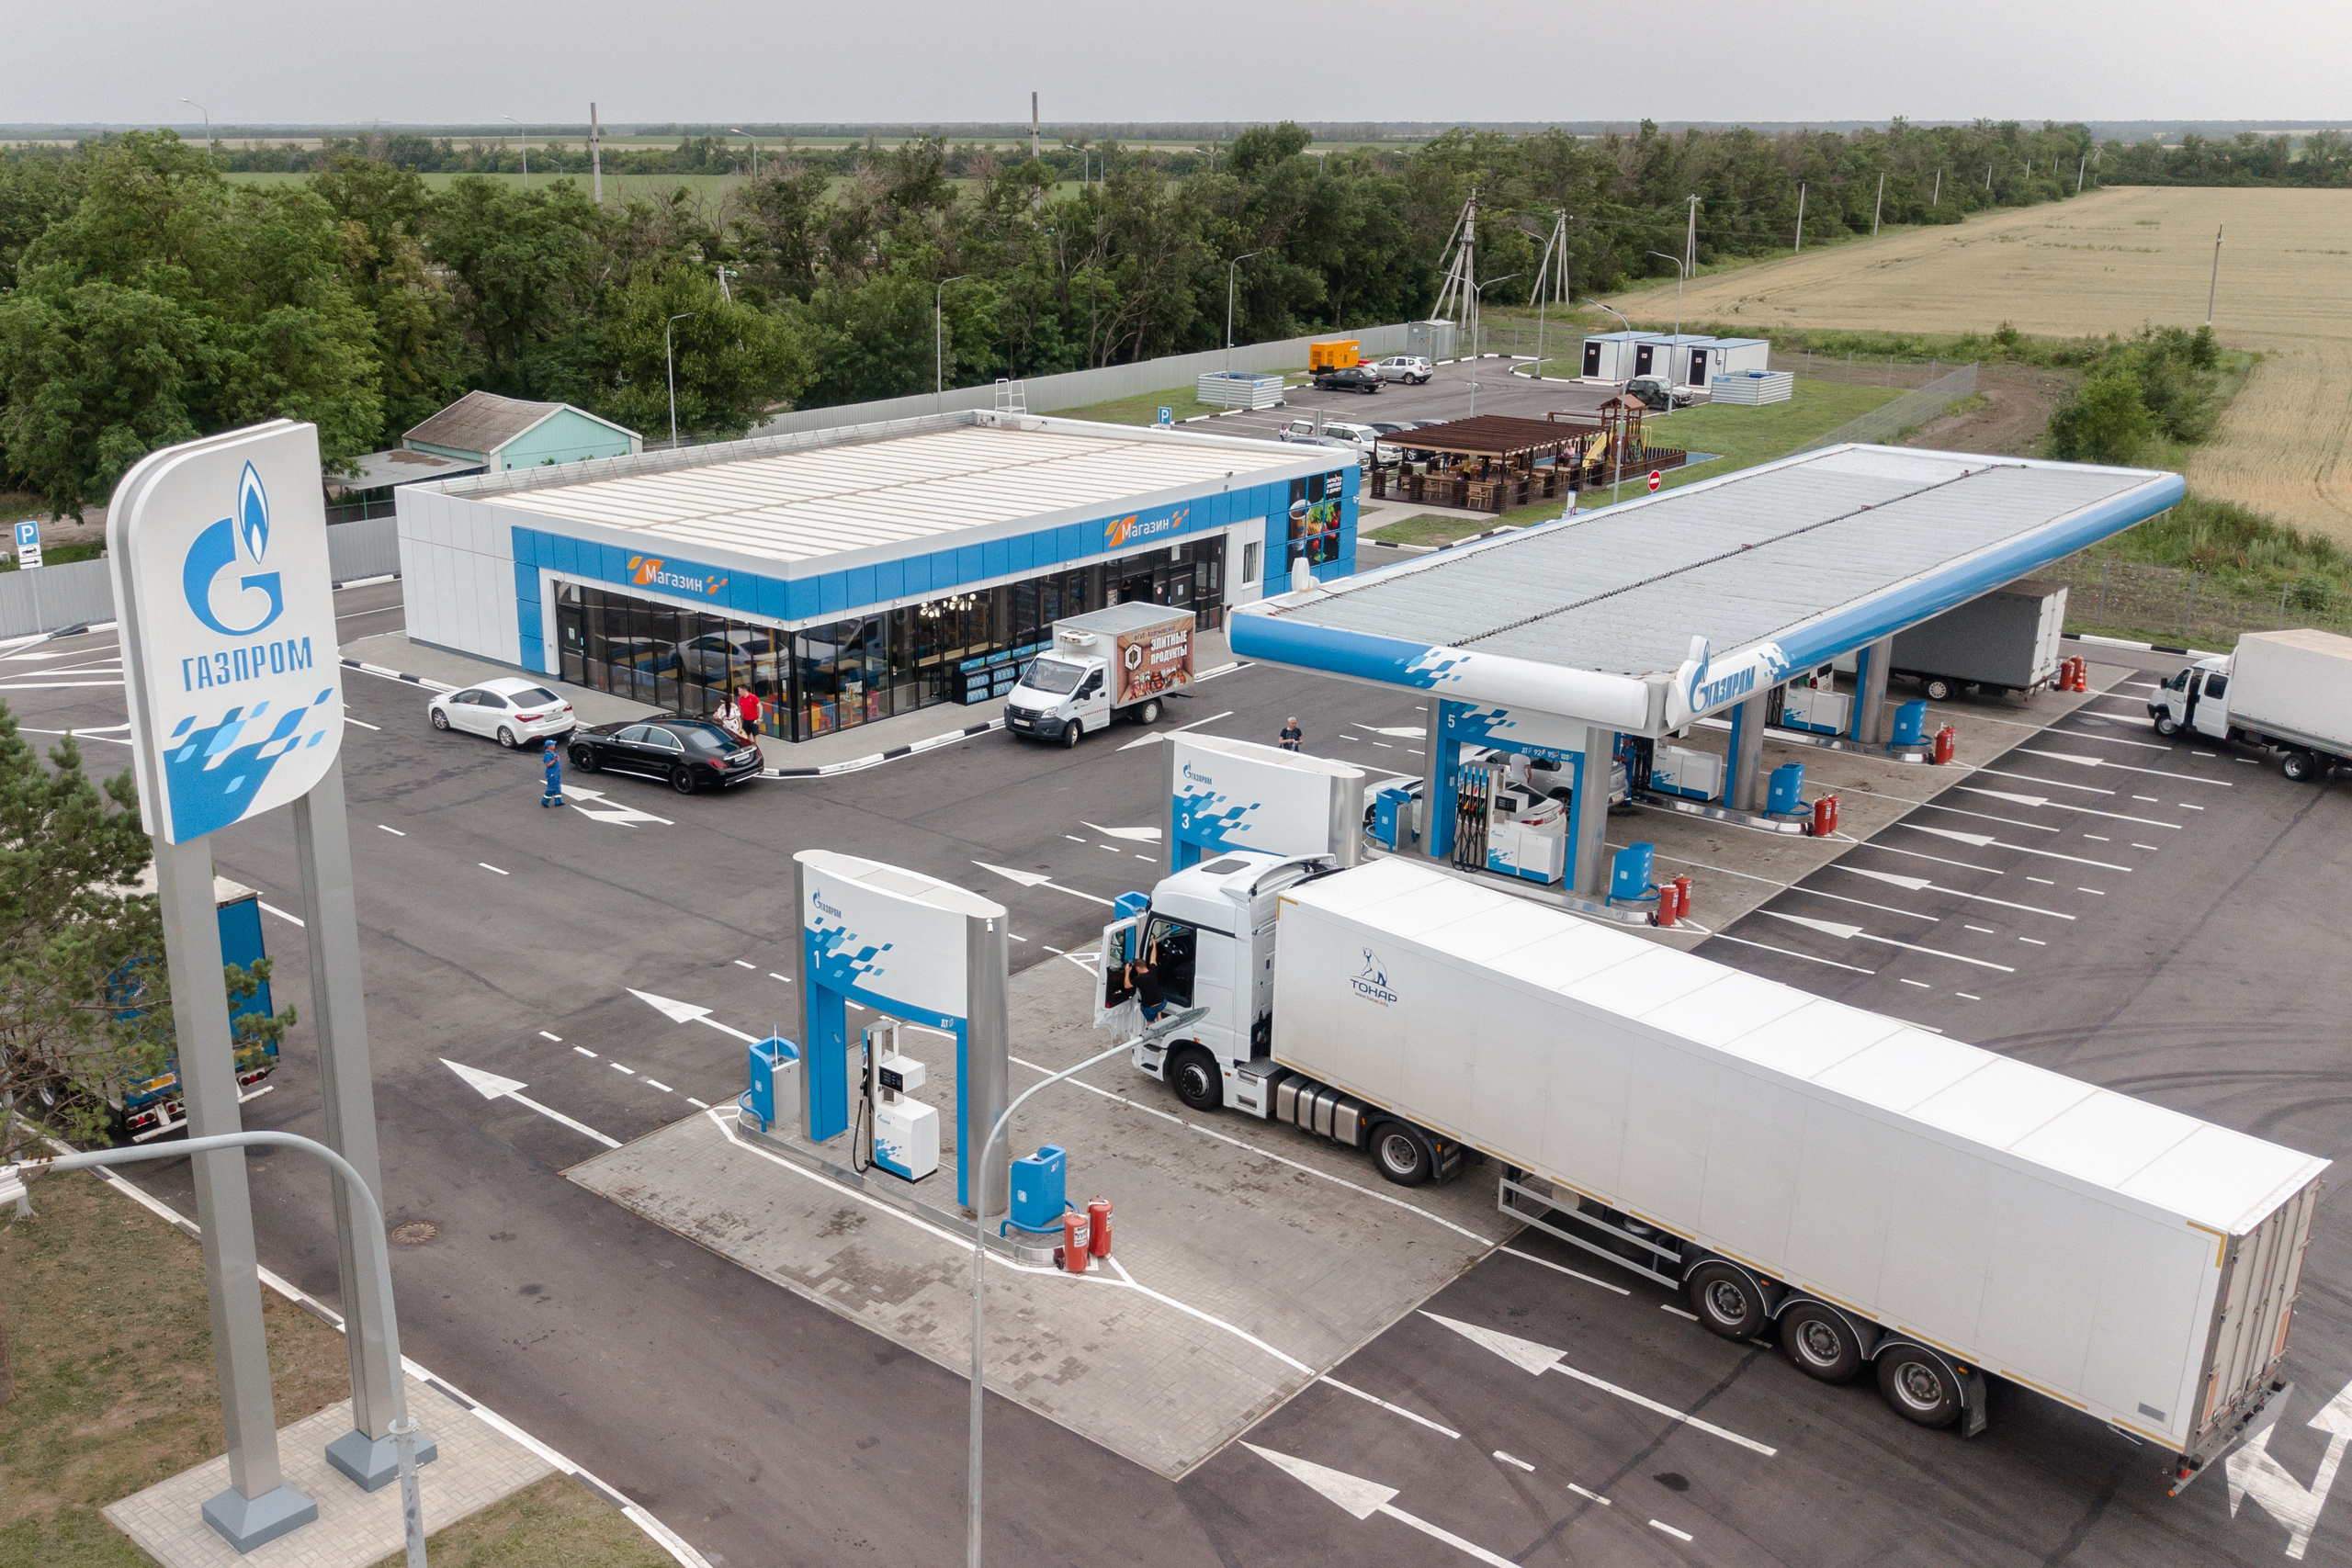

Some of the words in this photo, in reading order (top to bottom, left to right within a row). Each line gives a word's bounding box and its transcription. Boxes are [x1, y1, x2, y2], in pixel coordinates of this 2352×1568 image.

[1161, 409, 1170, 423] P
[21, 525, 35, 544] P
[1121, 518, 1170, 540] Магазин
[645, 564, 703, 592] Магазин
[1150, 630, 1188, 651] ЭЛИТНЫЕ
[1150, 644, 1188, 665] ПРОДУКТЫ
[182, 637, 312, 692] ГАЗПРОМ
[1708, 665, 1756, 708] ГАЗПРОМ
[1447, 714, 1455, 728] 5
[1547, 750, 1555, 759] 95
[1191, 773, 1212, 785] ГАЗПРОМ
[1182, 812, 1190, 829] 3
[820, 902, 842, 919] ГАЗПРОМ
[813, 950, 820, 969] 1
[1350, 978, 1397, 1002] ТОНАР
